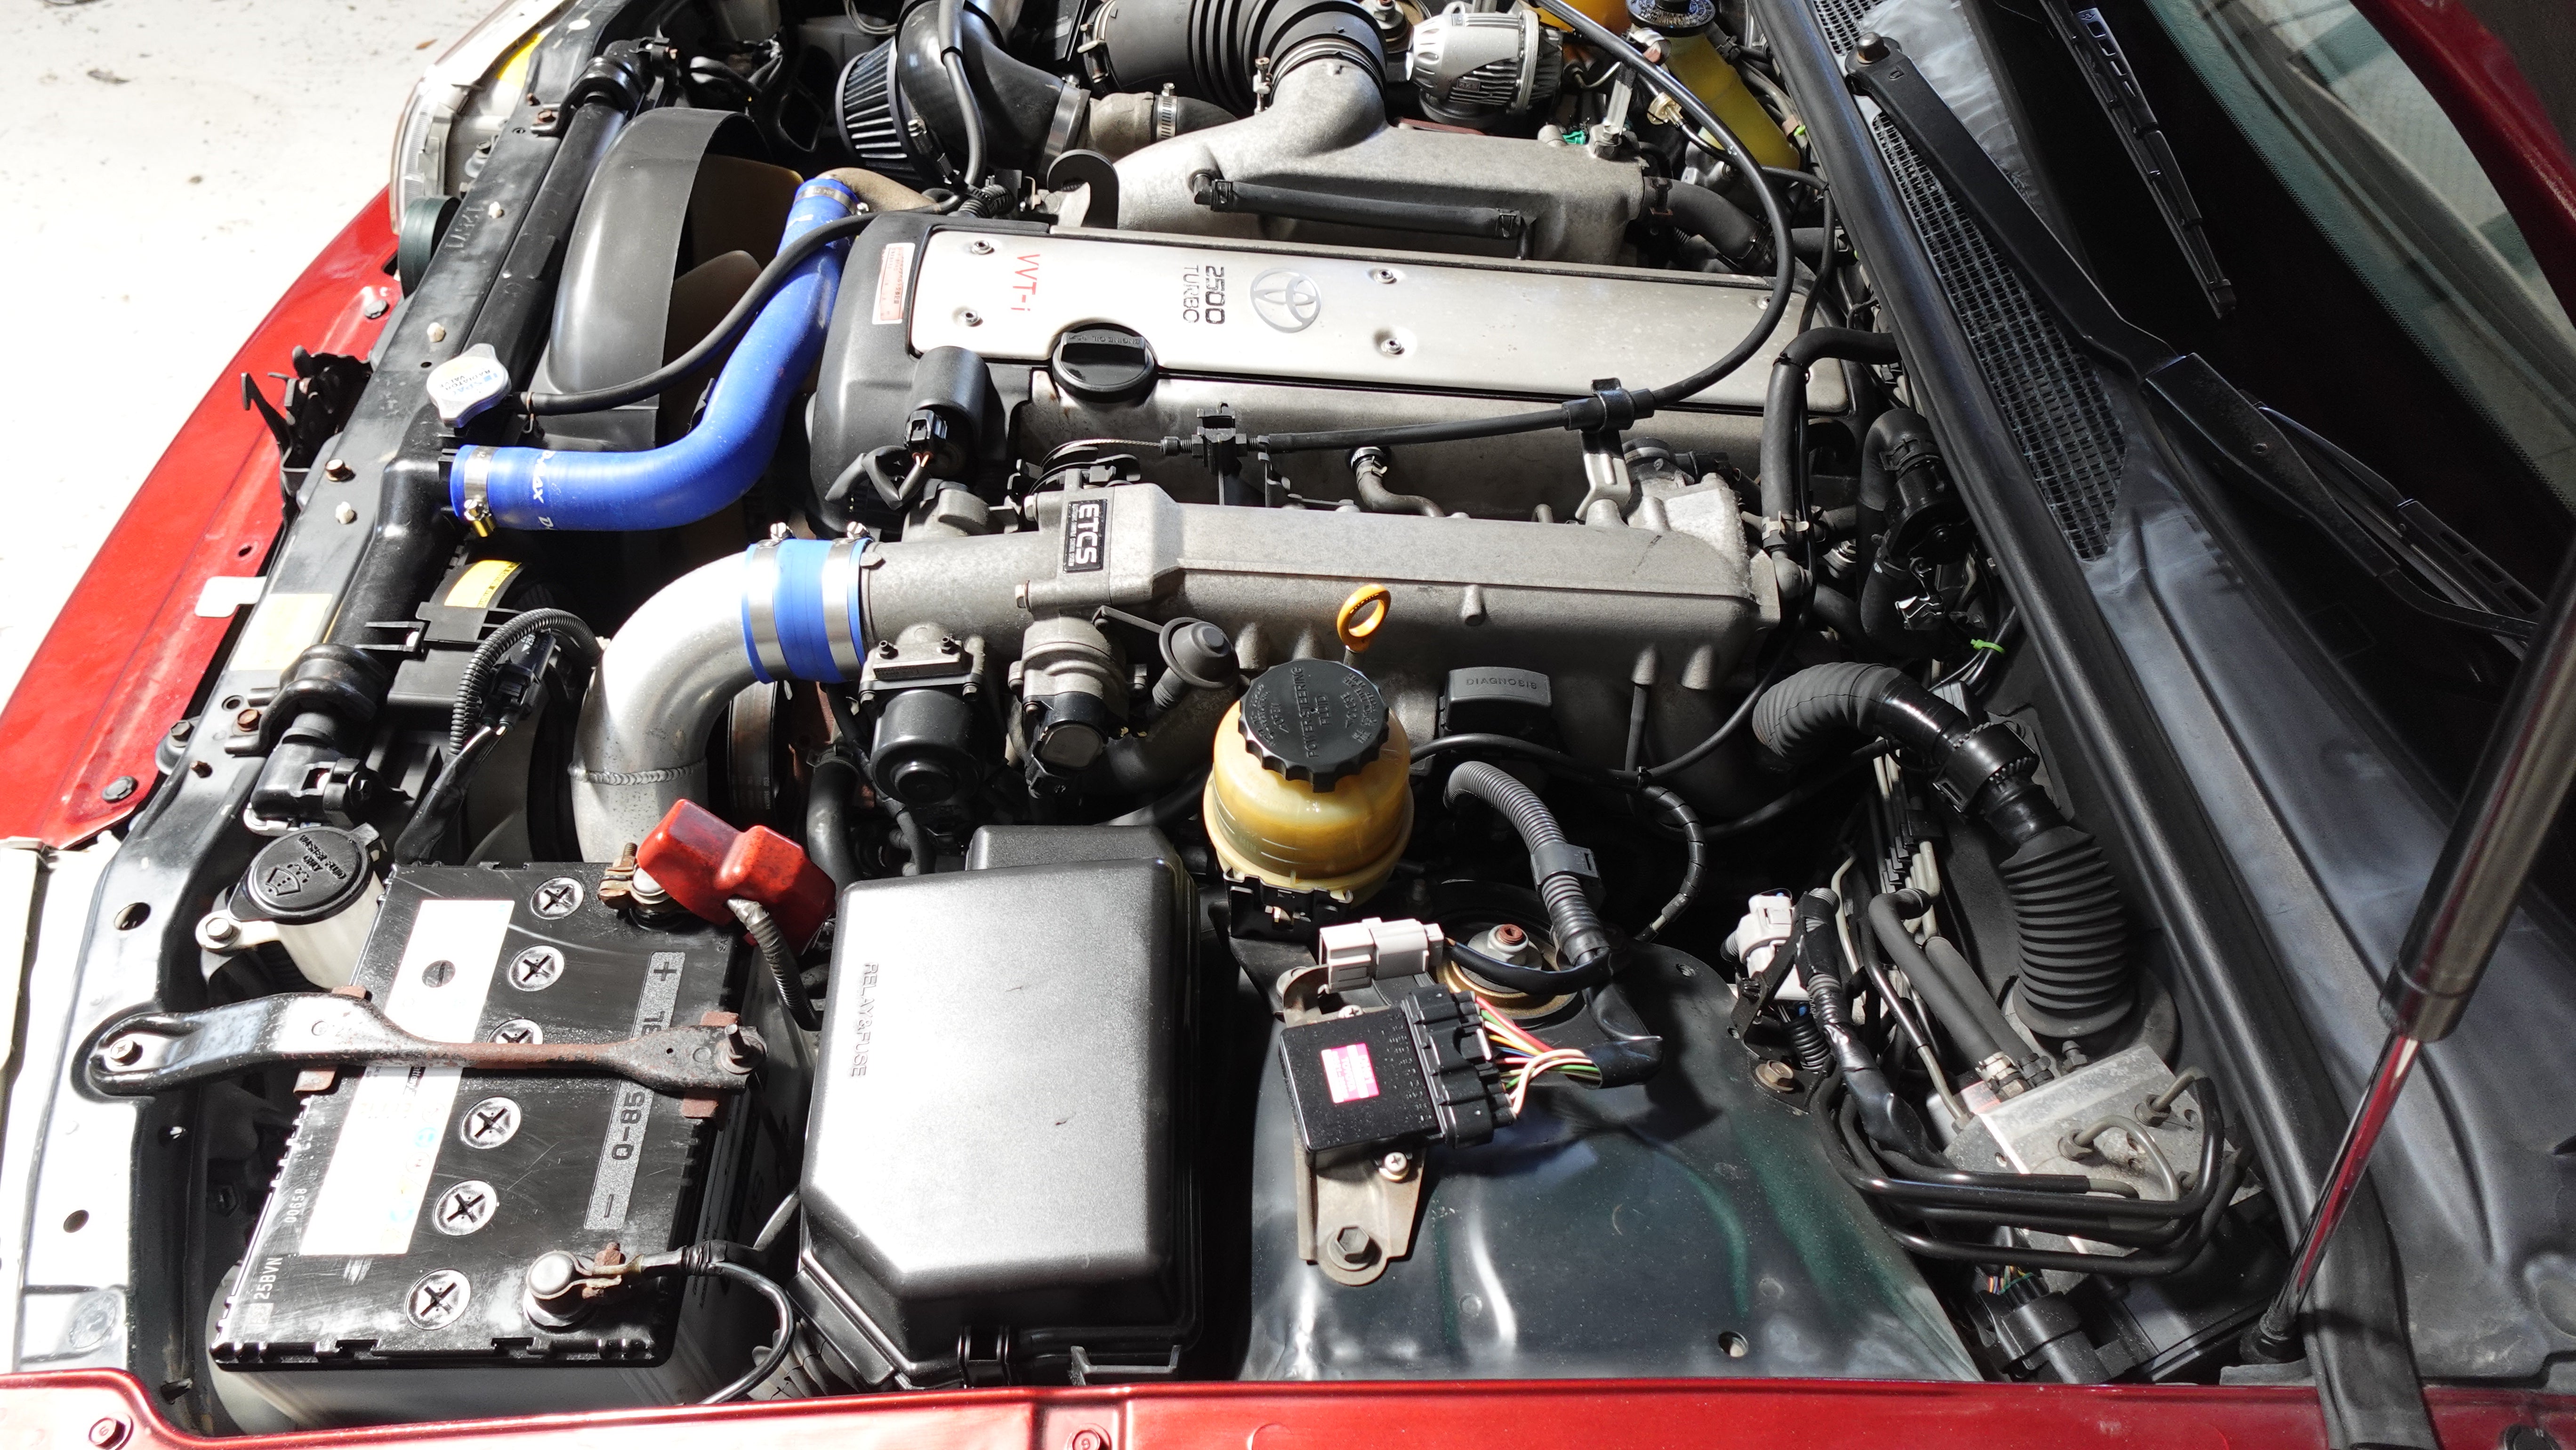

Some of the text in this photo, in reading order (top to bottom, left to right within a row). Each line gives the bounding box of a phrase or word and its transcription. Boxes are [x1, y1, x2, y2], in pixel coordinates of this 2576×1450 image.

[1011, 254, 1040, 312] VVT-i
[1183, 265, 1200, 323] TURBO
[1205, 265, 1225, 324] 2500
[1108, 336, 1140, 345] ENGINE
[446, 369, 491, 390] RADIATOR
[1076, 504, 1100, 564] ETCS
[1465, 677, 1537, 689] DIAGNOSIS
[1290, 666, 1319, 758] POWER STEERING
[1315, 694, 1332, 726] FLUID
[1340, 692, 1358, 720] CLOSE
[851, 963, 879, 1077] RELAY&FUSE
[1341, 1056, 1357, 1092] TOYOTA
[612, 1091, 645, 1160] Q-85
[284, 1188, 307, 1224] 00658
[253, 1257, 283, 1300] 25BVN
